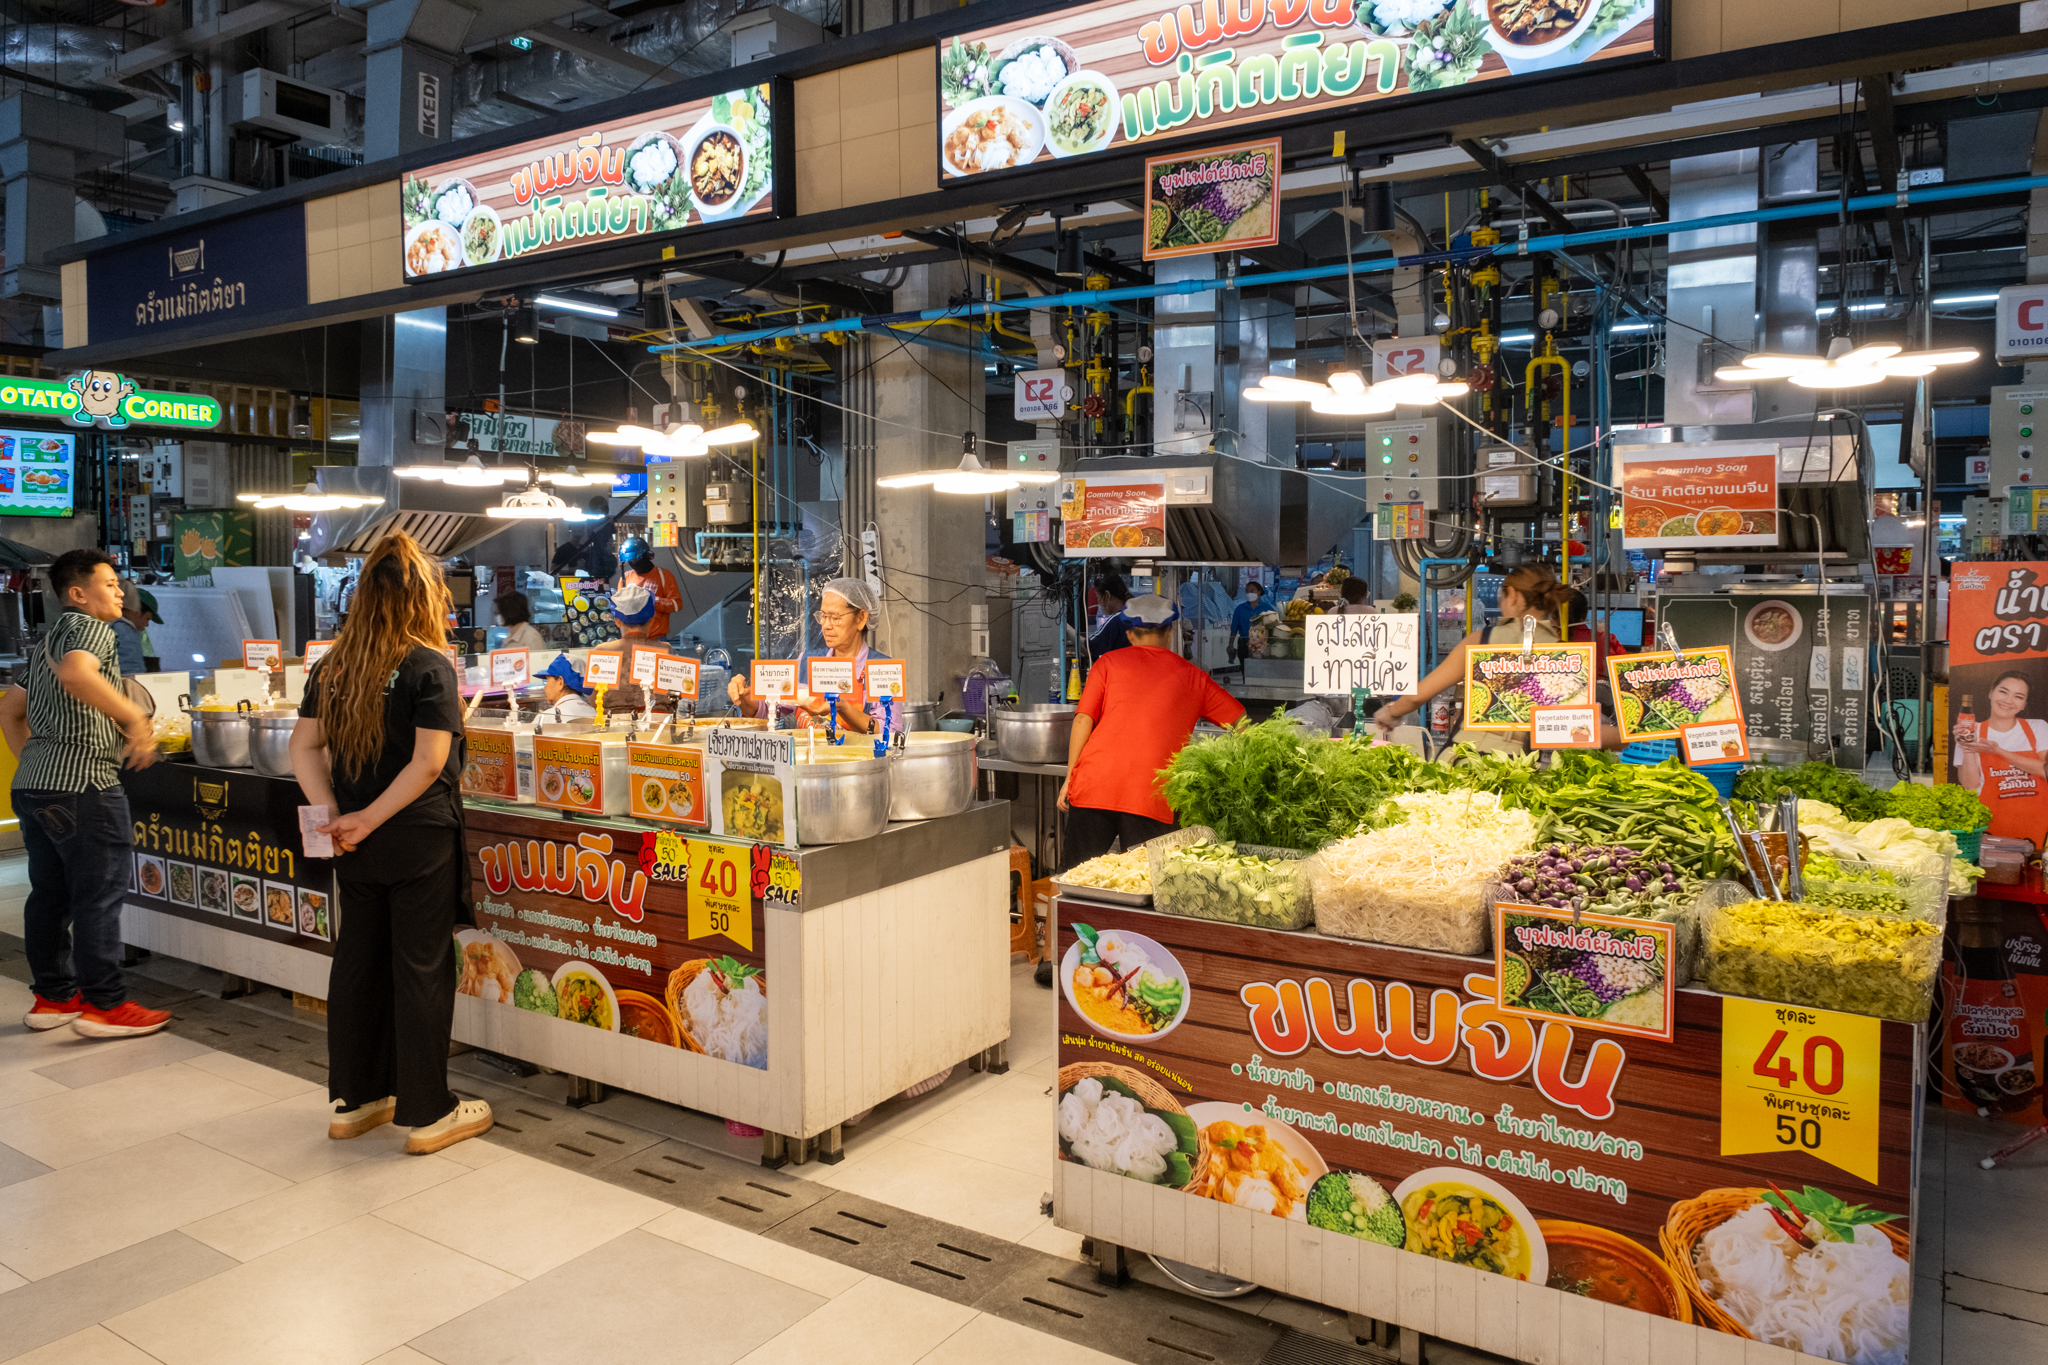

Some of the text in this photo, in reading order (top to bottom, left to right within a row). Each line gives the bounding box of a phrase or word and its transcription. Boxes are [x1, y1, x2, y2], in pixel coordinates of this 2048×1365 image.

[1139, 0, 1354, 65] ขนมจน
[1121, 31, 1400, 141] แม่กิตติยา
[509, 131, 625, 204] ขนมจีน
[1159, 153, 1267, 197] บุฟเฟต์ผักฟรี
[501, 186, 648, 259] แม่กิตติยา
[135, 276, 246, 326] ครัวแม่กิตติยา
[1386, 348, 1426, 376] C2
[1025, 378, 1054, 402] C2
[1656, 463, 1748, 476] Comming Soon
[1086, 489, 1146, 499] Comming Soon
[1630, 481, 1769, 499] ร้าน กิตติยาขนมจีน
[1315, 615, 1389, 656] ถุงใส่ผัก
[1846, 608, 1861, 639] บาท
[1975, 622, 2041, 651] ตรา
[759, 665, 790, 678] น้ำยากะทิ
[1479, 653, 1582, 679] บุฟเฟต์ผักฟรี
[1537, 713, 1593, 722] Vegetable Buffet
[1687, 728, 1739, 740] Vegetable Buffet
[1834, 696, 1859, 747] ลวกจิ้ม
[537, 744, 600, 767] ขนมจีนน้ำยากะทิ
[132, 812, 295, 879] ครัวแม่กิตติยา
[708, 844, 725, 855] ชุดละ
[479, 832, 648, 923] ขนมจีน
[652, 861, 688, 881] SALE
[700, 858, 737, 898] 40
[704, 898, 741, 913] พิเศษชุดละ
[764, 885, 799, 906] SALE
[523, 909, 585, 933] แกงเขียวหวาน
[592, 916, 658, 948] น้ำยาไทย/ลาว
[710, 911, 729, 932] 50
[575, 939, 590, 959] ไก่
[624, 951, 653, 977] ปลาทู
[1514, 924, 1656, 960] บุฟเฟต์ผักฟรี
[1775, 1008, 1816, 1025] ชุดละ
[1133, 1052, 1145, 1063] สด
[1146, 1057, 1194, 1093] อร่อยแน่นอน
[1753, 1029, 1844, 1096] 40
[1246, 1054, 1644, 1161] น้ำยาป่า แกงเขียวหวาน น้ำยาไทย/ลาว
[1763, 1092, 1851, 1121] พิเศษชุดละ
[1775, 1113, 1821, 1149] 50
[1262, 1095, 1629, 1205] น้ำยากะทิ แกงไตปลา ไก่ ตีนไก่ ปลาทู
